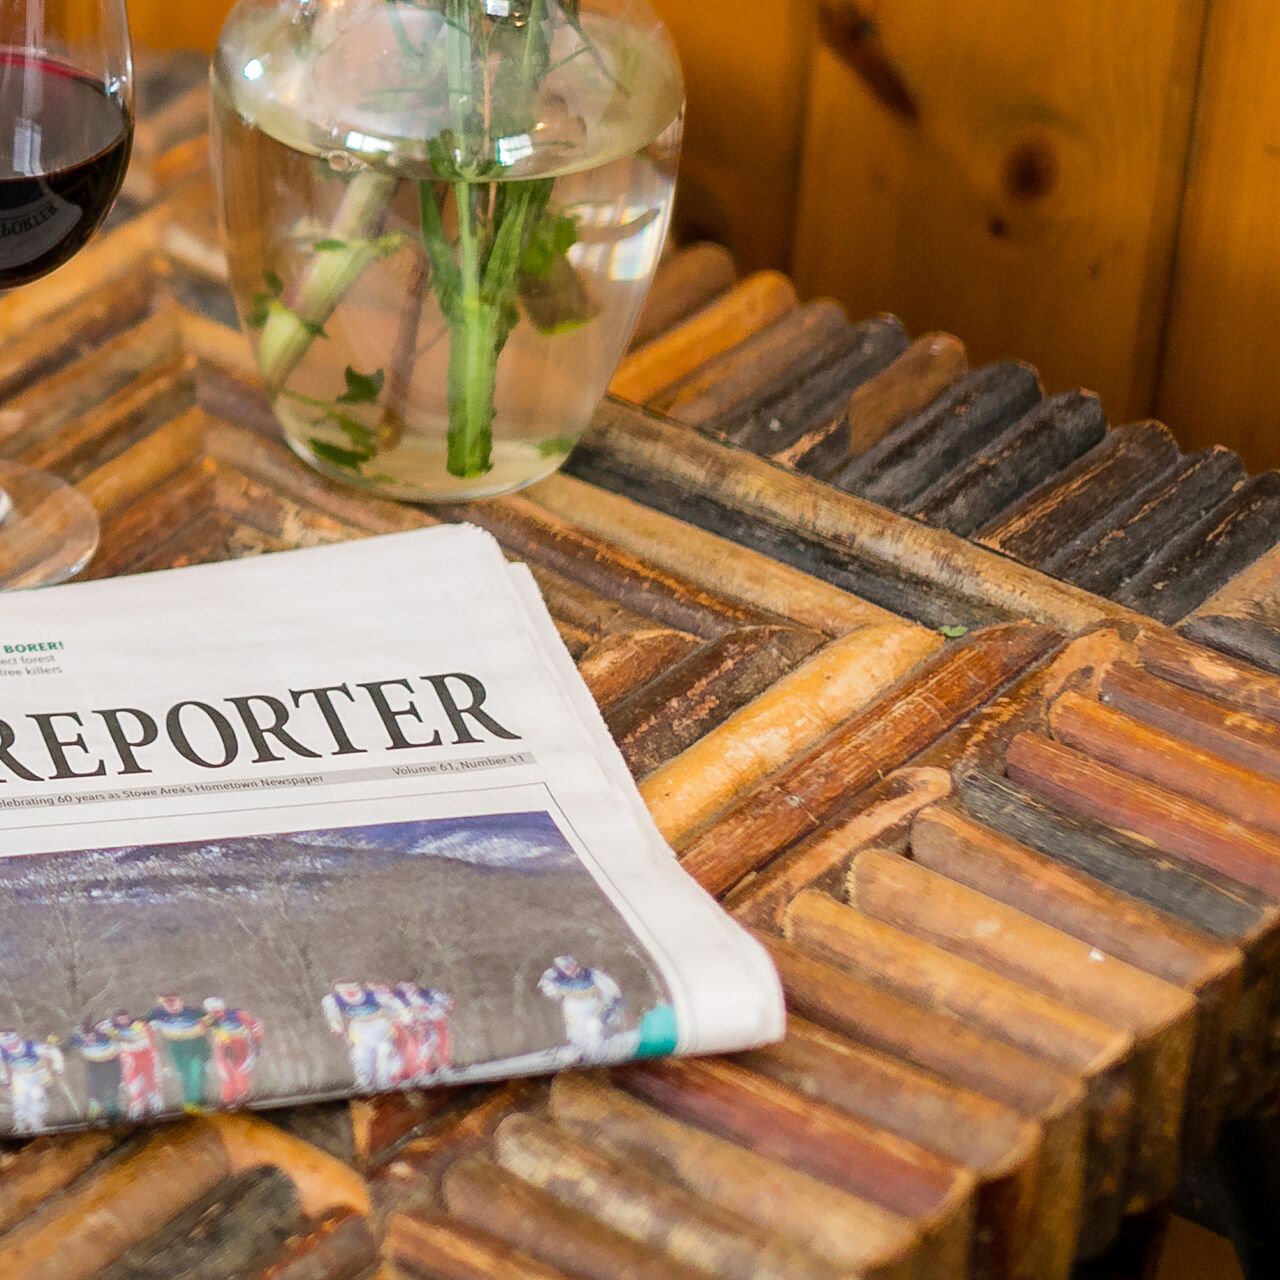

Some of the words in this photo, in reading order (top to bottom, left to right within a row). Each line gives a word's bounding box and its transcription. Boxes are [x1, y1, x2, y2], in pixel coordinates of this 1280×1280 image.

[4, 641, 65, 654] BORER!
[20, 654, 56, 665] forest
[26, 665, 64, 676] killers
[57, 794, 73, 804] 60
[74, 793, 106, 804] years
[108, 791, 121, 800] as
[122, 789, 157, 800] Stowe
[160, 785, 193, 796] Area's
[195, 781, 258, 793] Hometown
[260, 774, 324, 788] Newspaper
[392, 765, 439, 777] Volume
[440, 762, 460, 772] 61,
[460, 758, 507, 770] Number
[508, 754, 525, 764] 11
